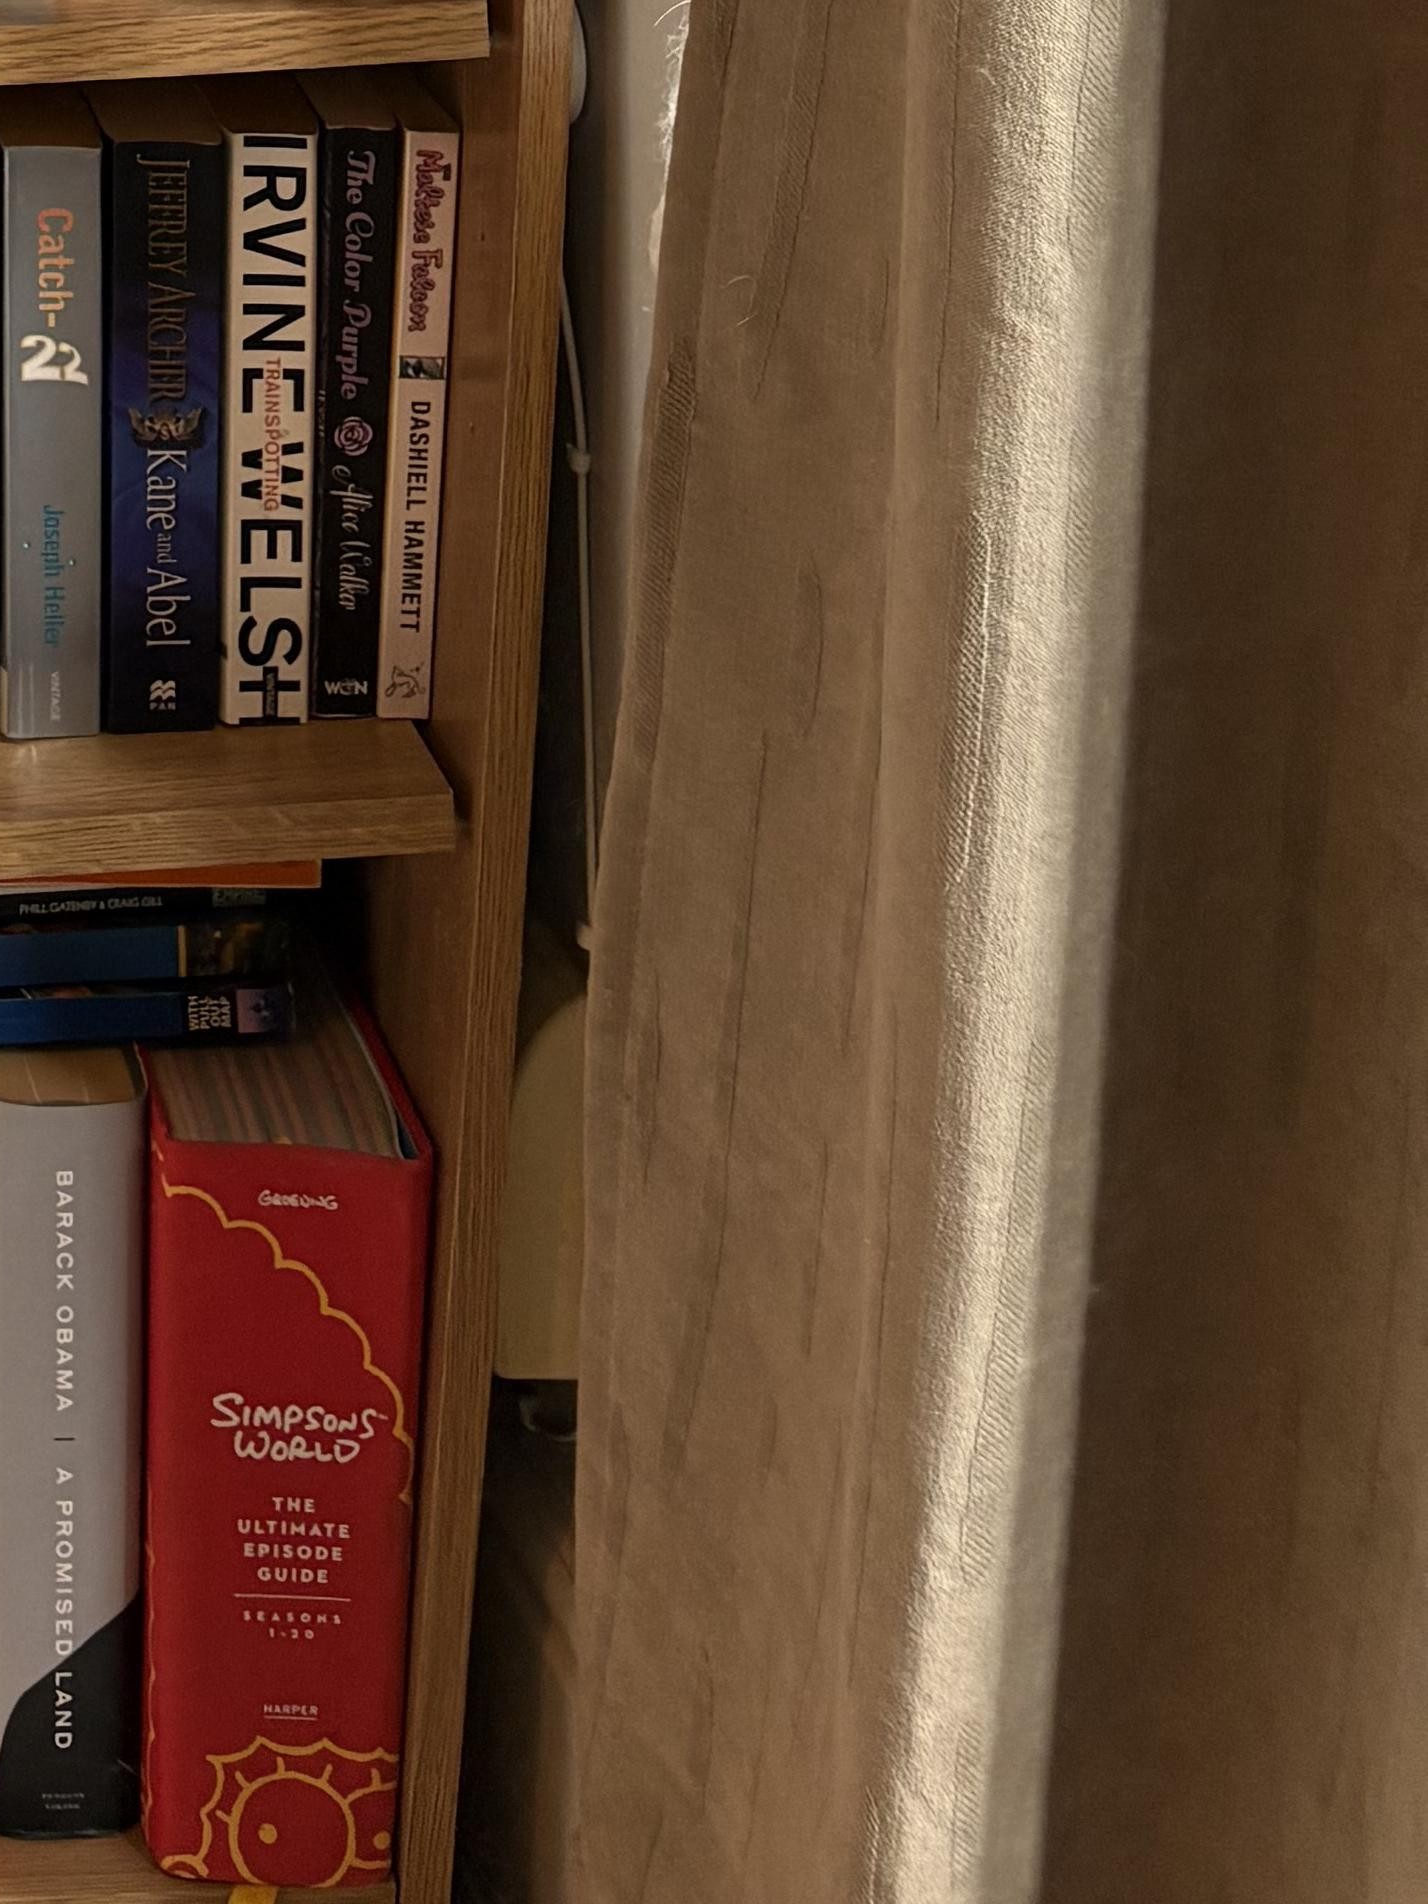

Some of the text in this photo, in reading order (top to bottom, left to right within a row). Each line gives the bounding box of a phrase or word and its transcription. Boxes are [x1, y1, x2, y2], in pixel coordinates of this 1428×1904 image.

[400, 400, 430, 633] DASHIELL HAMMETT
[53, 1170, 74, 1751] BARACK OBAMA A PROMISED LAND
